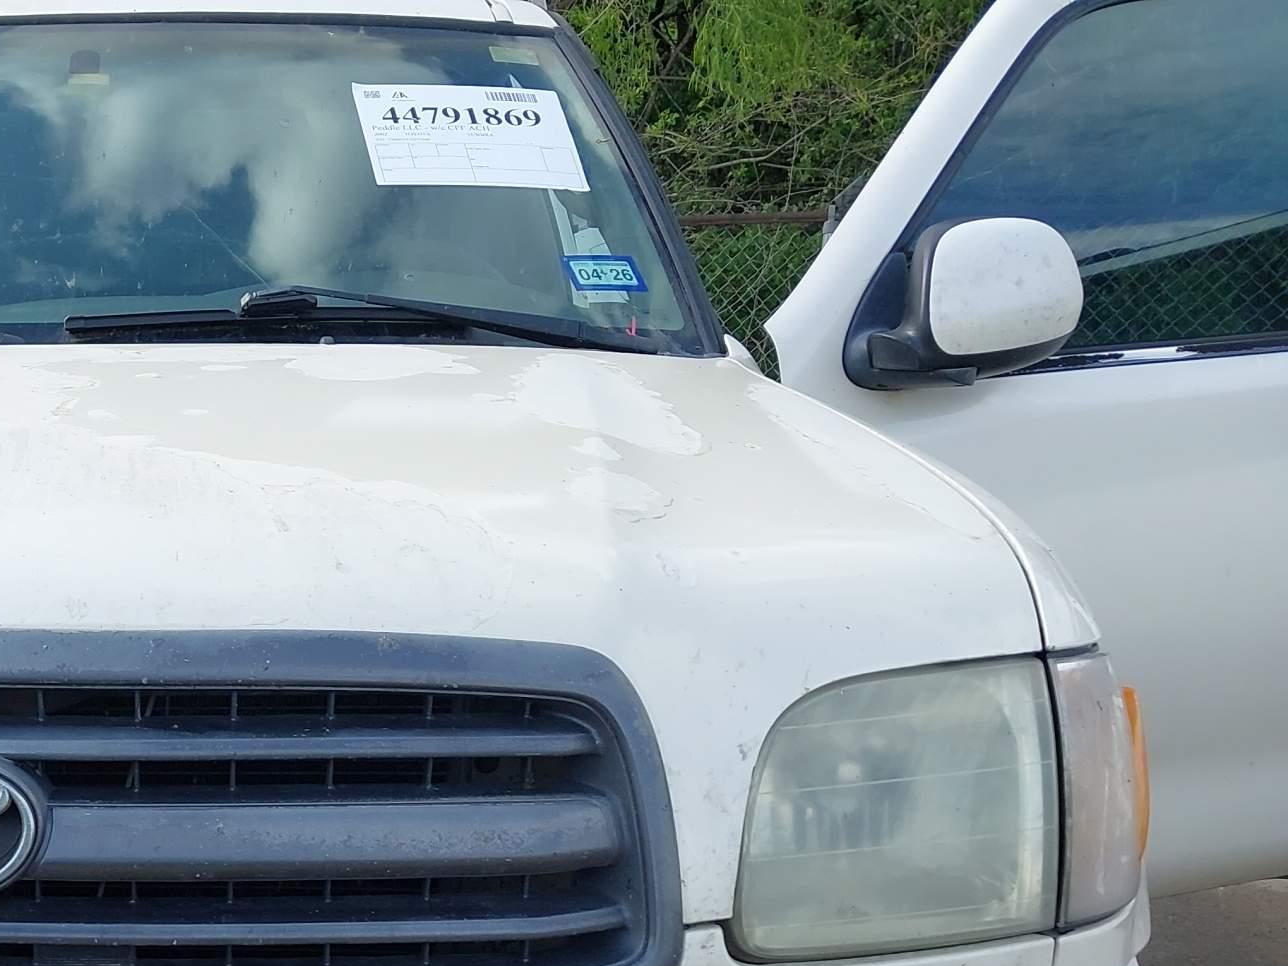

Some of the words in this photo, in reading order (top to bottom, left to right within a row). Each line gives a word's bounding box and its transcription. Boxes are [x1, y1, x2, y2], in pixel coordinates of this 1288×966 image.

[382, 106, 541, 127] 44791869
[578, 268, 602, 281] 04
[609, 268, 633, 281] 26
